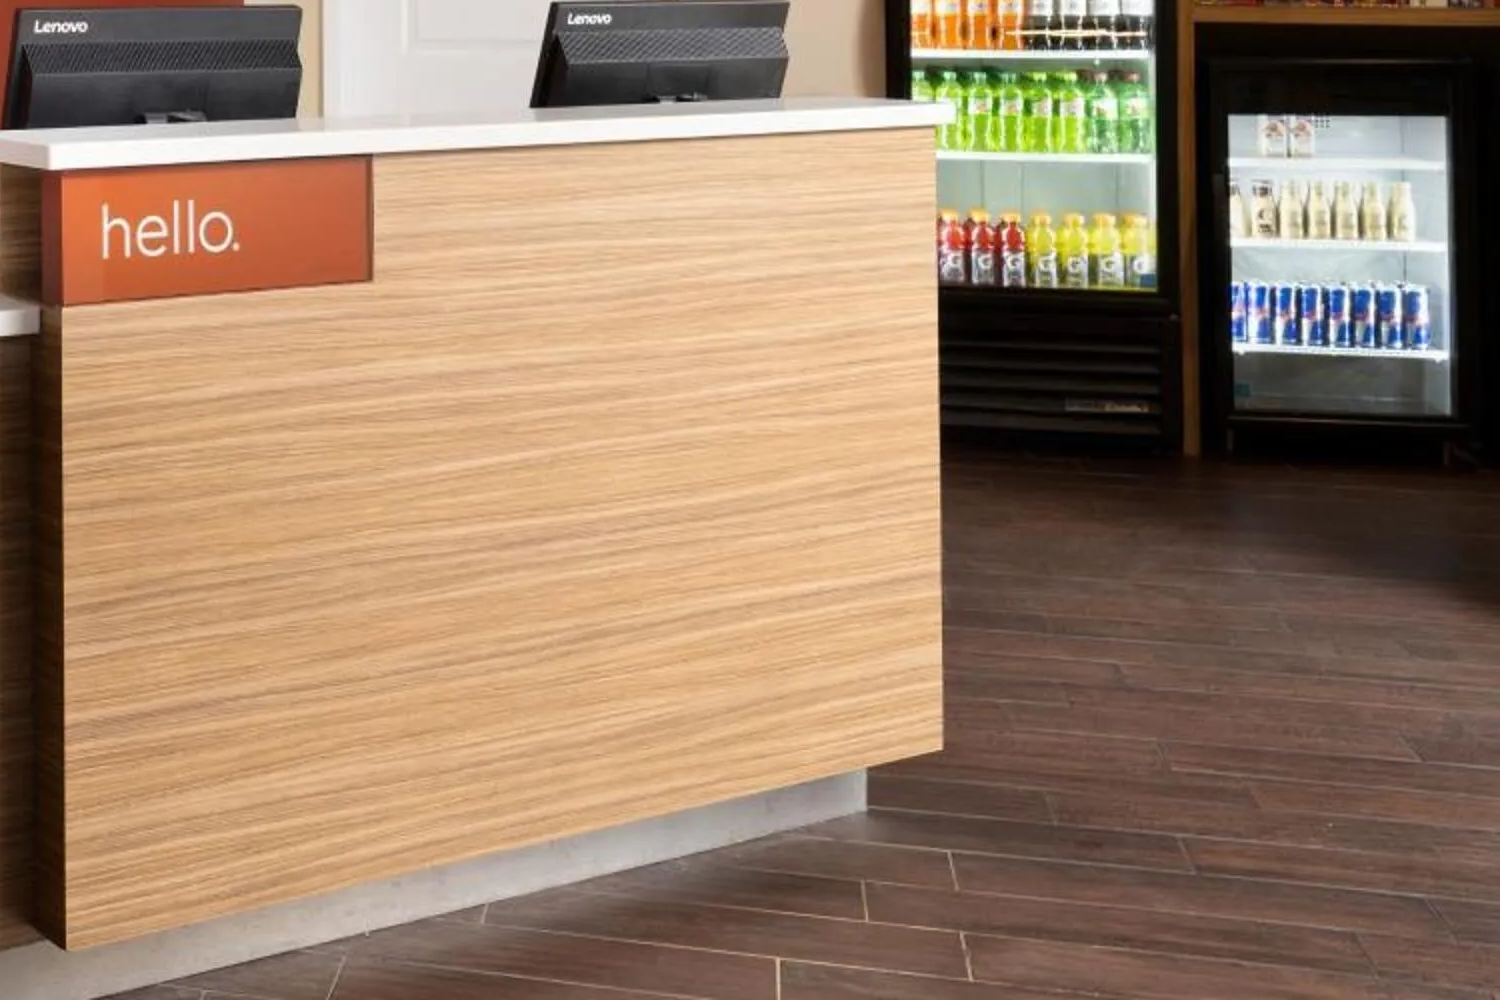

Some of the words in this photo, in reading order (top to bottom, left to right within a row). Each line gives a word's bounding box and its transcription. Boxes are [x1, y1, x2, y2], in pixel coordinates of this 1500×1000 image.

[567, 12, 612, 25] Lenovo
[33, 19, 88, 33] Lenovo
[101, 200, 240, 260] hello.
